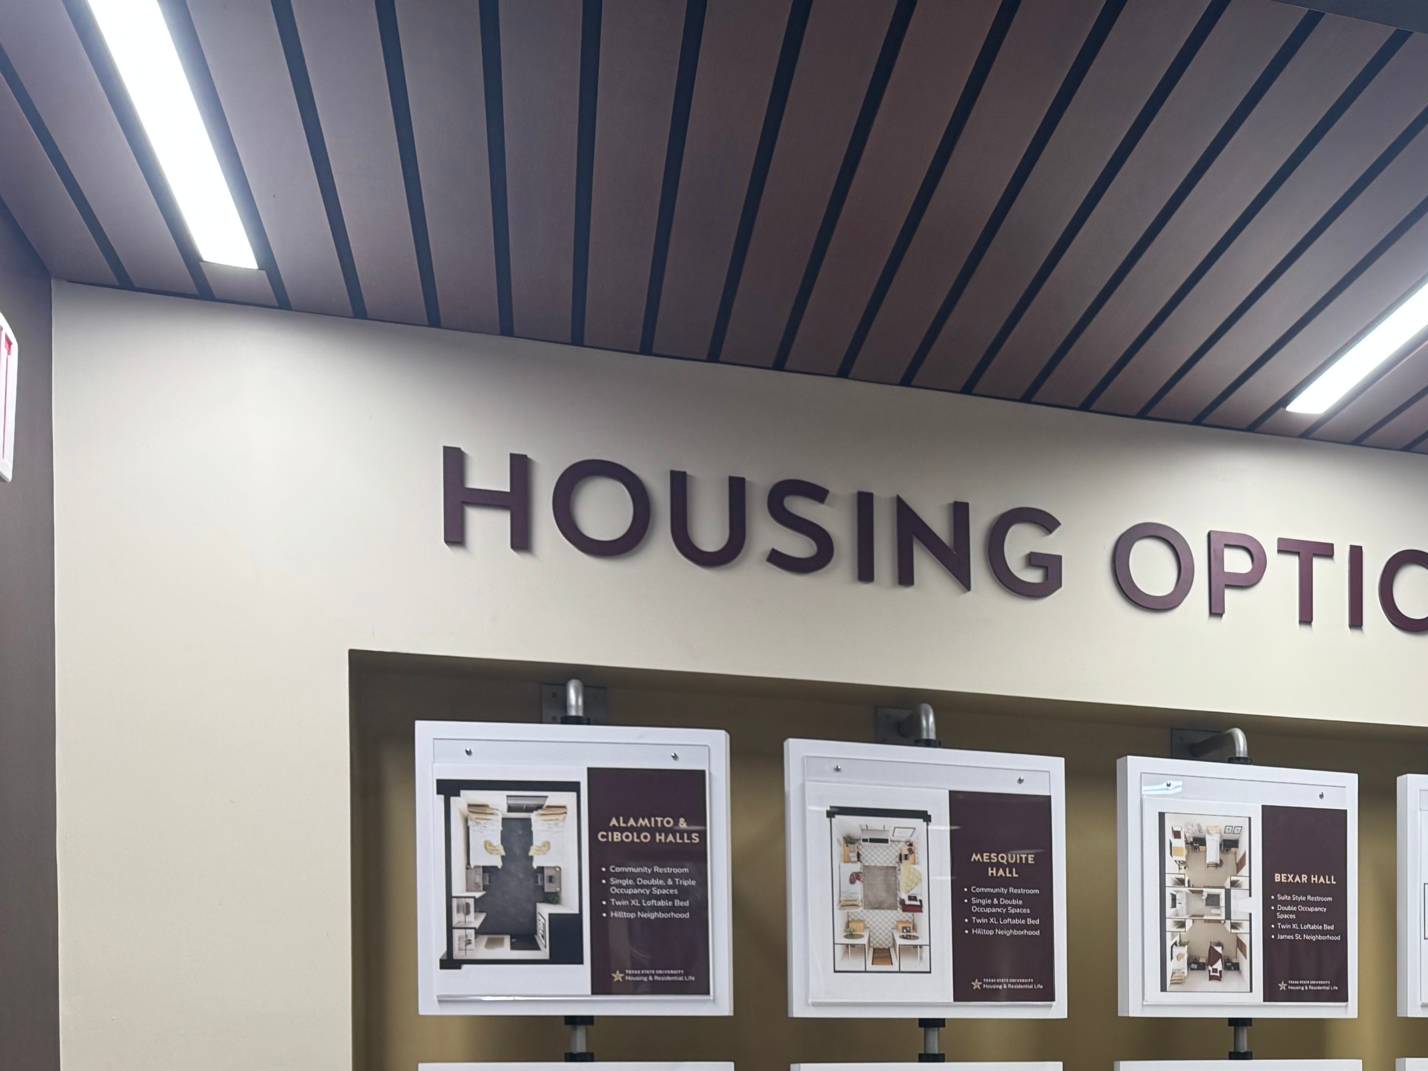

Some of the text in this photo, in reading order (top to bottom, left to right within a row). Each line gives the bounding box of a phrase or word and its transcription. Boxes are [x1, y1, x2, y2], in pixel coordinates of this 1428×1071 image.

[442, 446, 1064, 600] HOUSING
[609, 816, 688, 828] ALAMITO &
[597, 831, 700, 843] CIBOLO HALLS
[609, 865, 689, 874] Community Restroom
[971, 853, 1035, 877] MESQUITE HALL
[1274, 873, 1336, 884] BEXAR HALL
[610, 887, 650, 895] Occupancy
[971, 886, 1008, 894] Community
[610, 911, 636, 919] Hilltop
